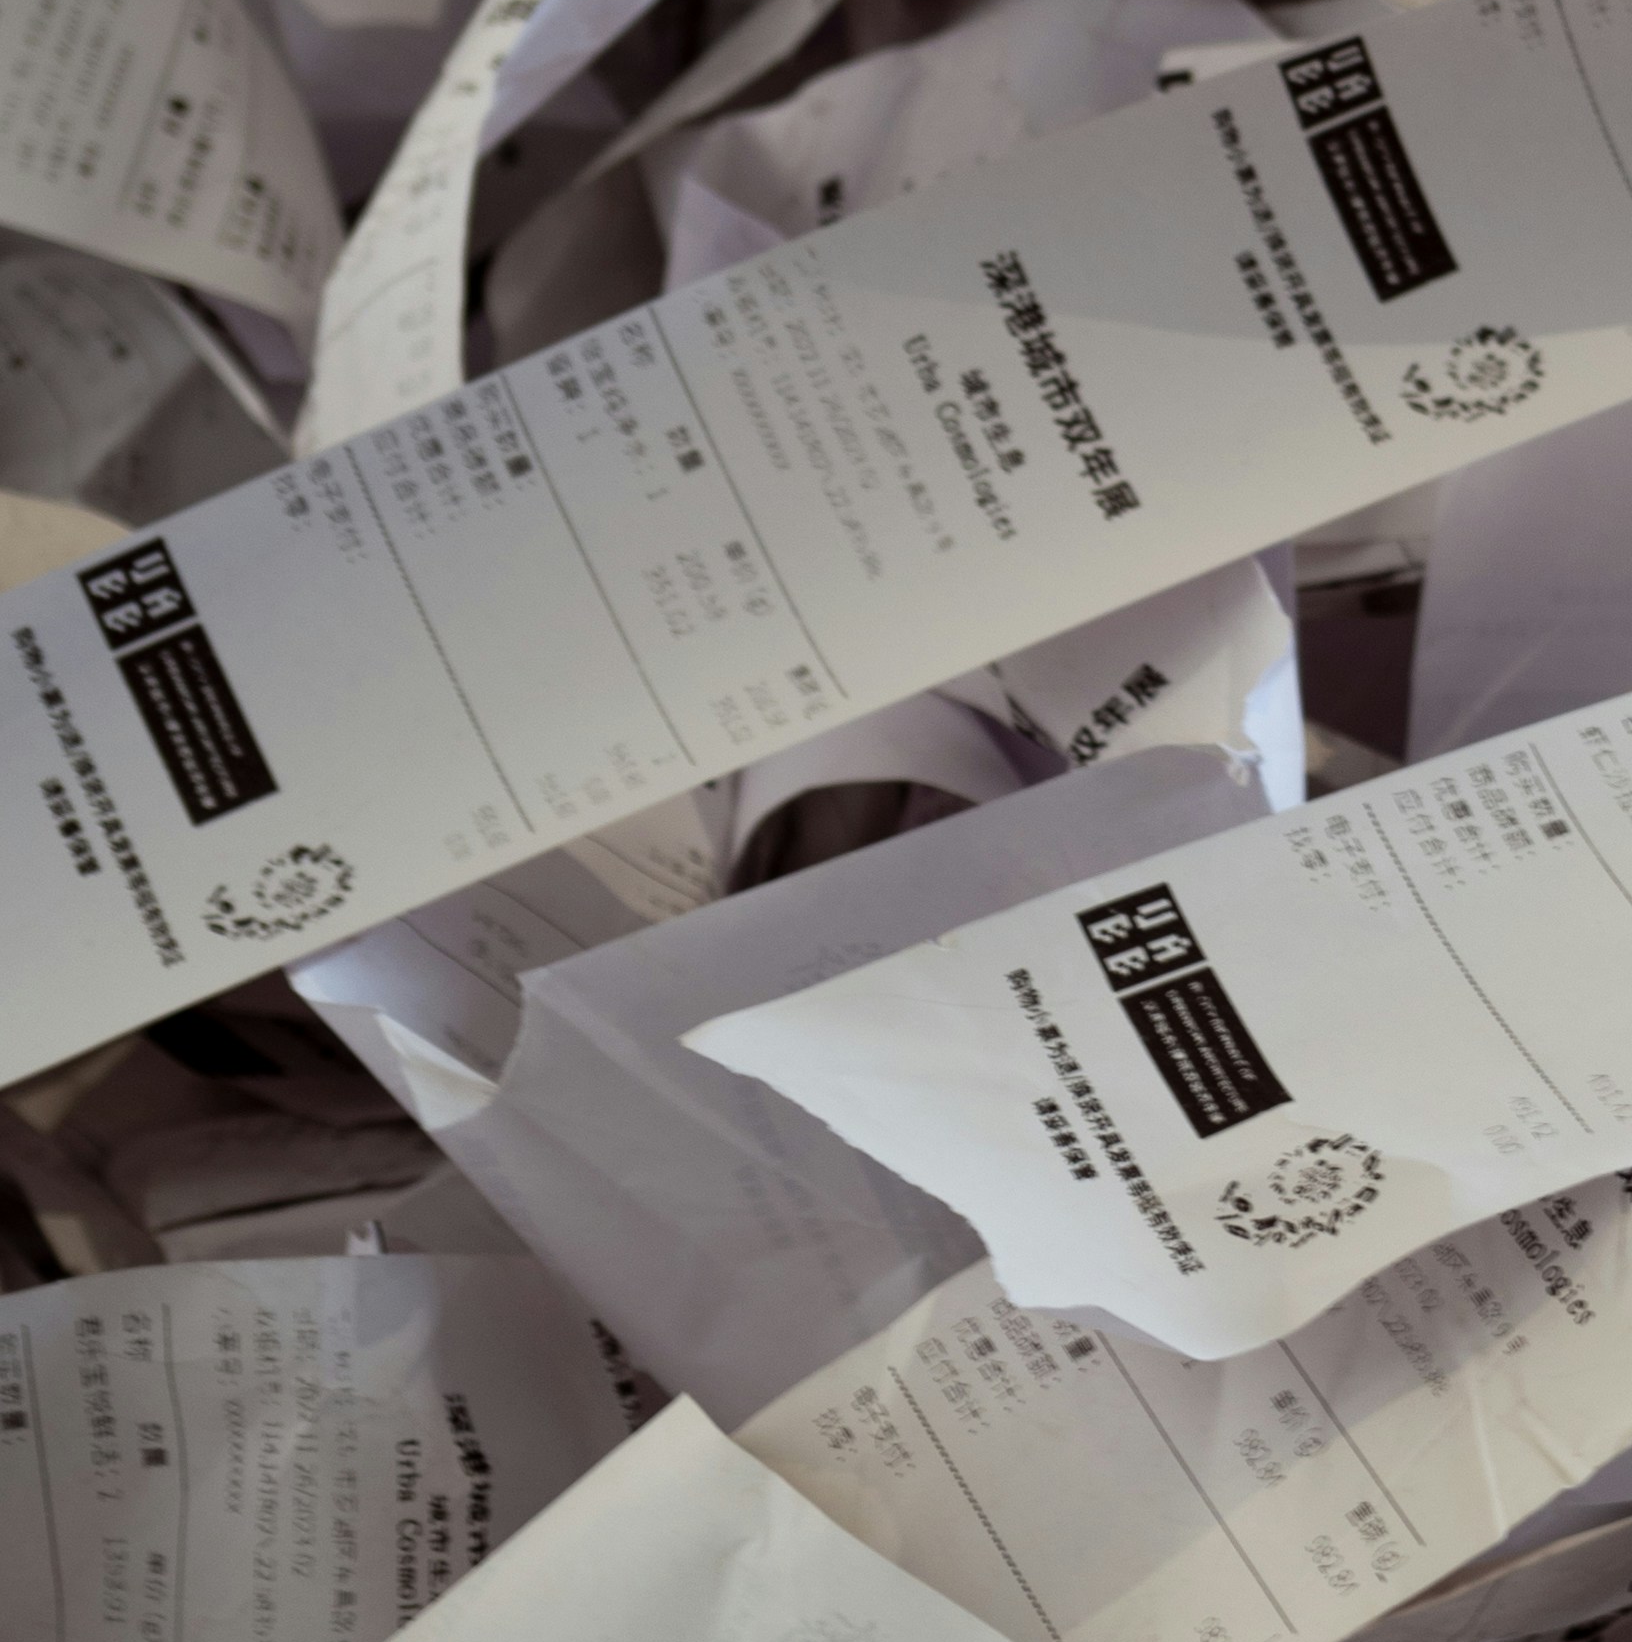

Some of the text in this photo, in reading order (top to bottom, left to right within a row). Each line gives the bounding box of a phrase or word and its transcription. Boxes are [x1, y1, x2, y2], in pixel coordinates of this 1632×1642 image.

[953, 365, 1027, 475] 城市生息
[976, 247, 1145, 523] 深港城市双年展
[930, 395, 1024, 544] Cosmologies
[1126, 894, 1195, 968] UA
[1497, 1202, 1601, 1329] osmologies
